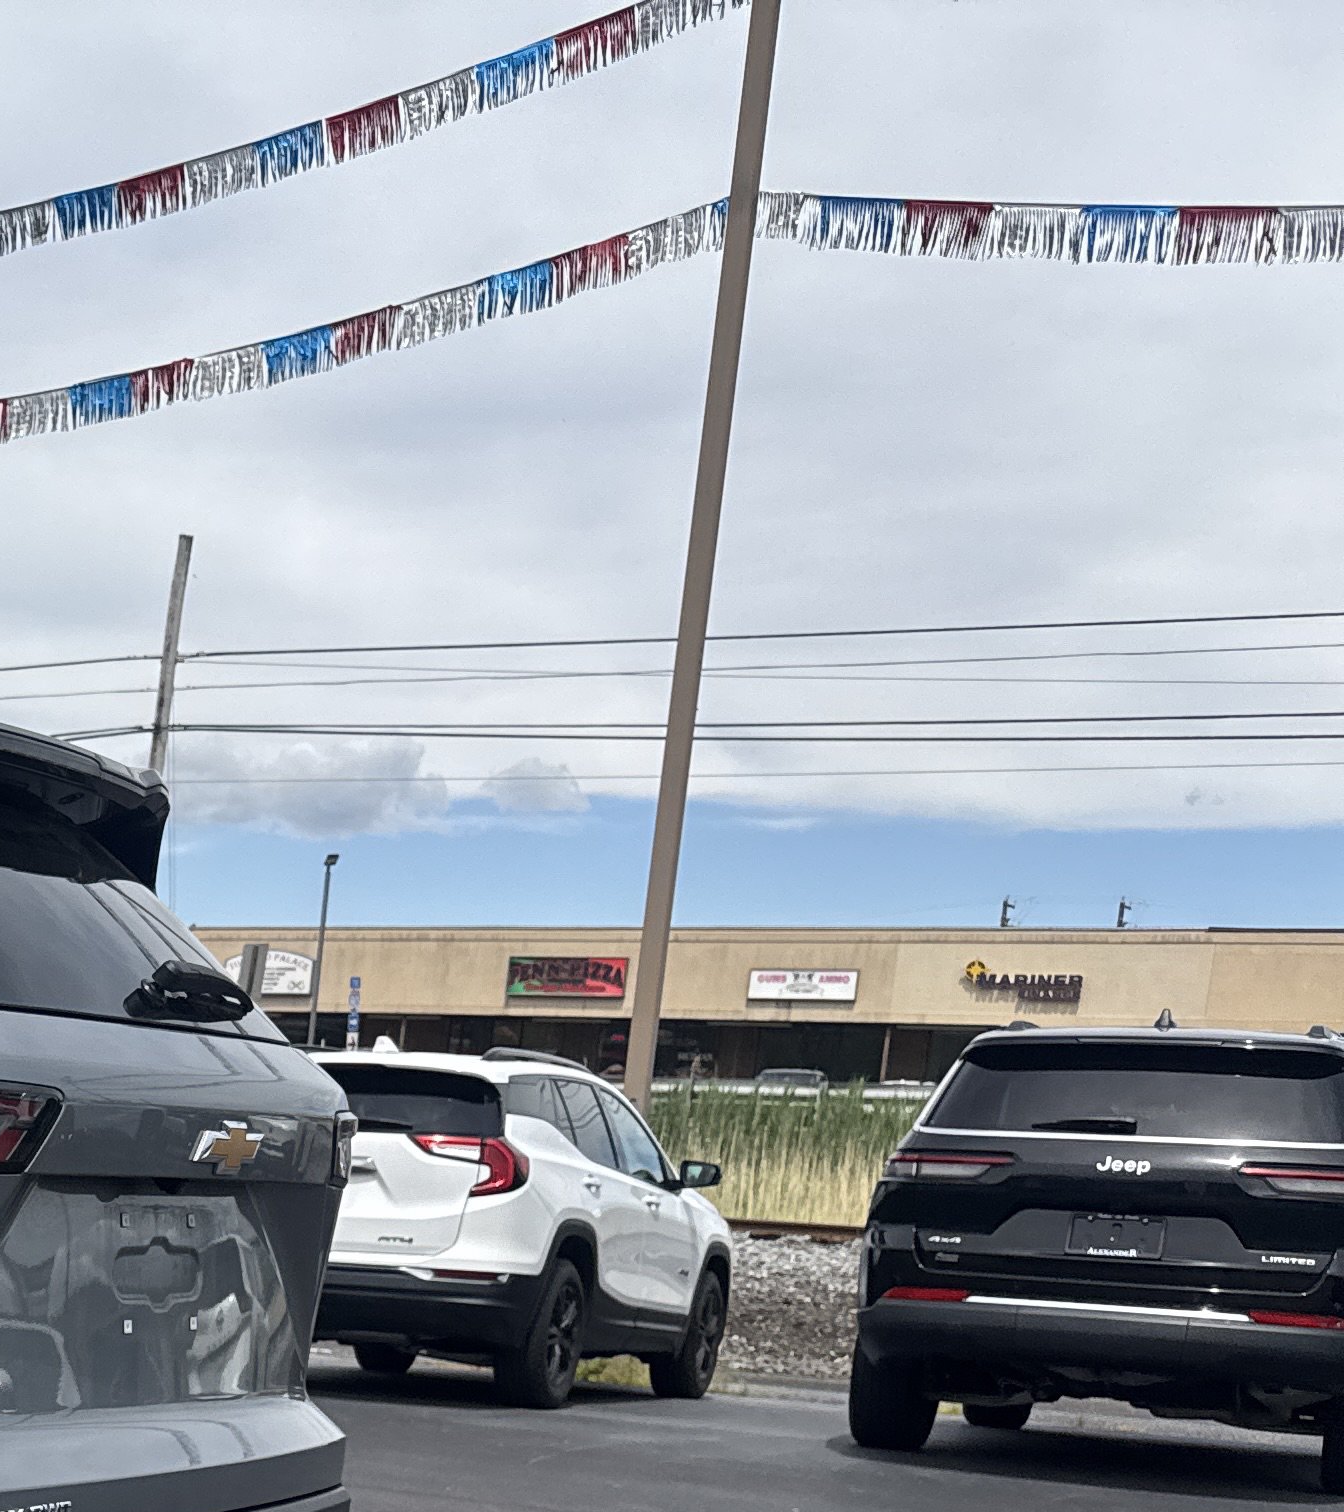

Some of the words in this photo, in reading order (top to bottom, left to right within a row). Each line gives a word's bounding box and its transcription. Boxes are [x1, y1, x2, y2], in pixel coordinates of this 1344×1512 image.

[975, 973, 1083, 990] MARINER
[1096, 1155, 1151, 1176] Jeep
[1261, 1255, 1316, 1266] LIMITED
